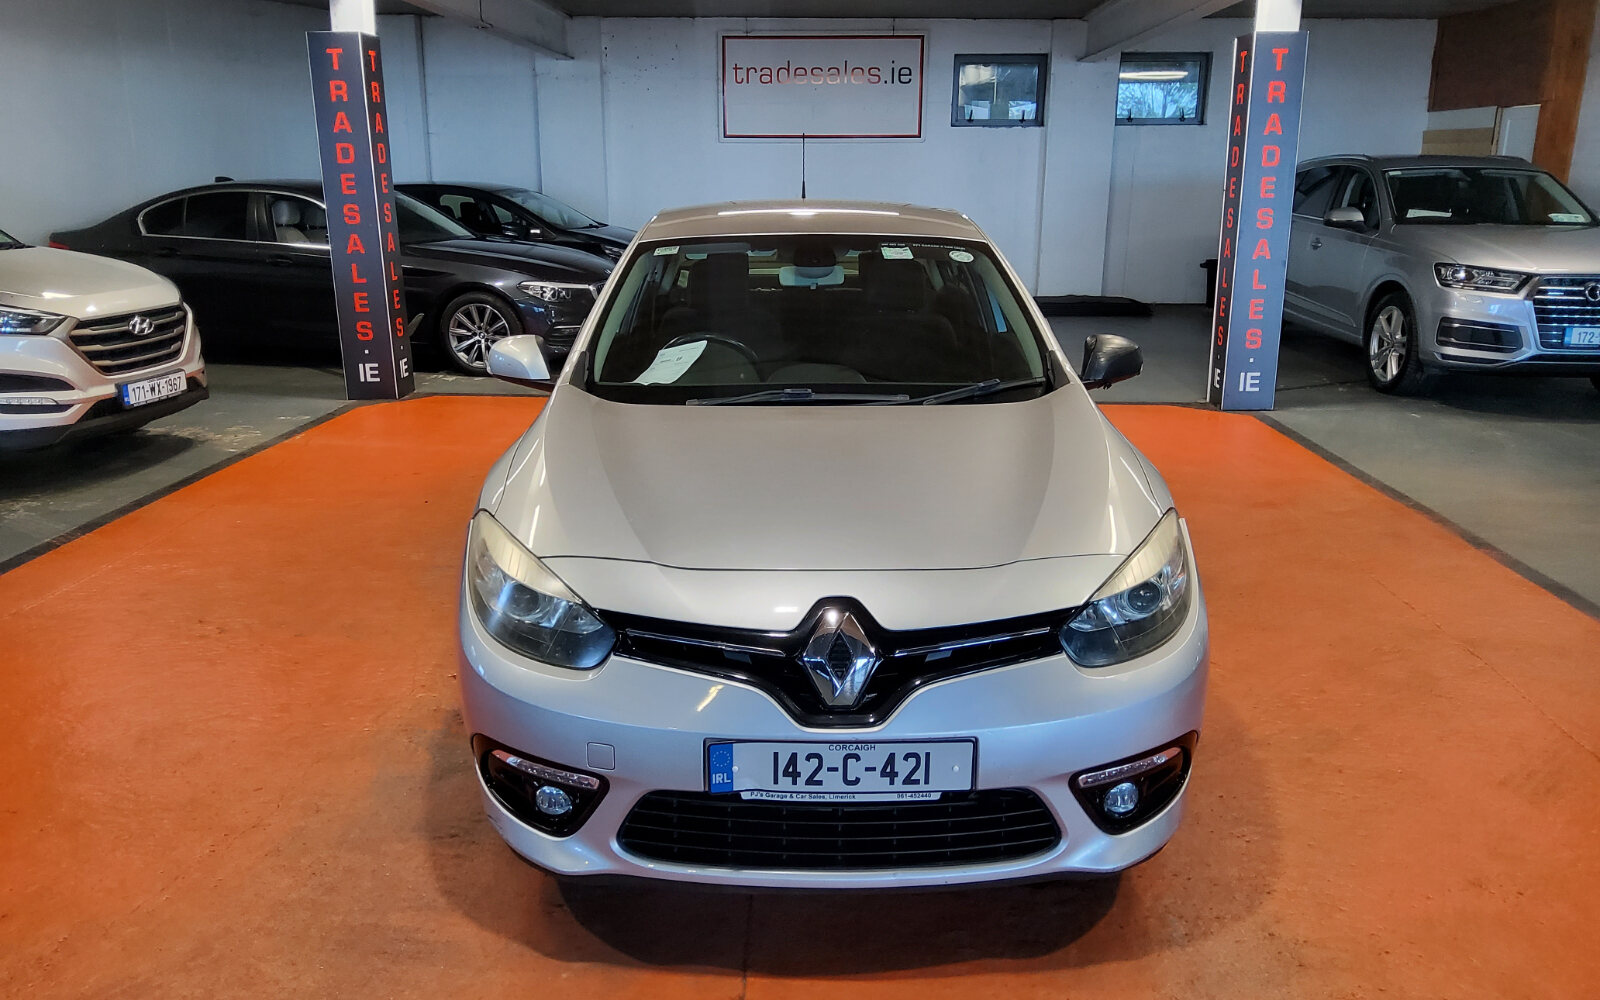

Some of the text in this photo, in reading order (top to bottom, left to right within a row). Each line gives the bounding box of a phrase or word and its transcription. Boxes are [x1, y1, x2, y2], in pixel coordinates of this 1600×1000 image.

[732, 60, 912, 85] tradesales.ie
[1577, 331, 1600, 344] 172-
[131, 376, 182, 401] 171-WX-1967
[828, 743, 876, 752] CORCAIGH
[772, 751, 931, 787] 142-C-421
[712, 772, 732, 785] IRL
[765, 792, 788, 800] Garage
